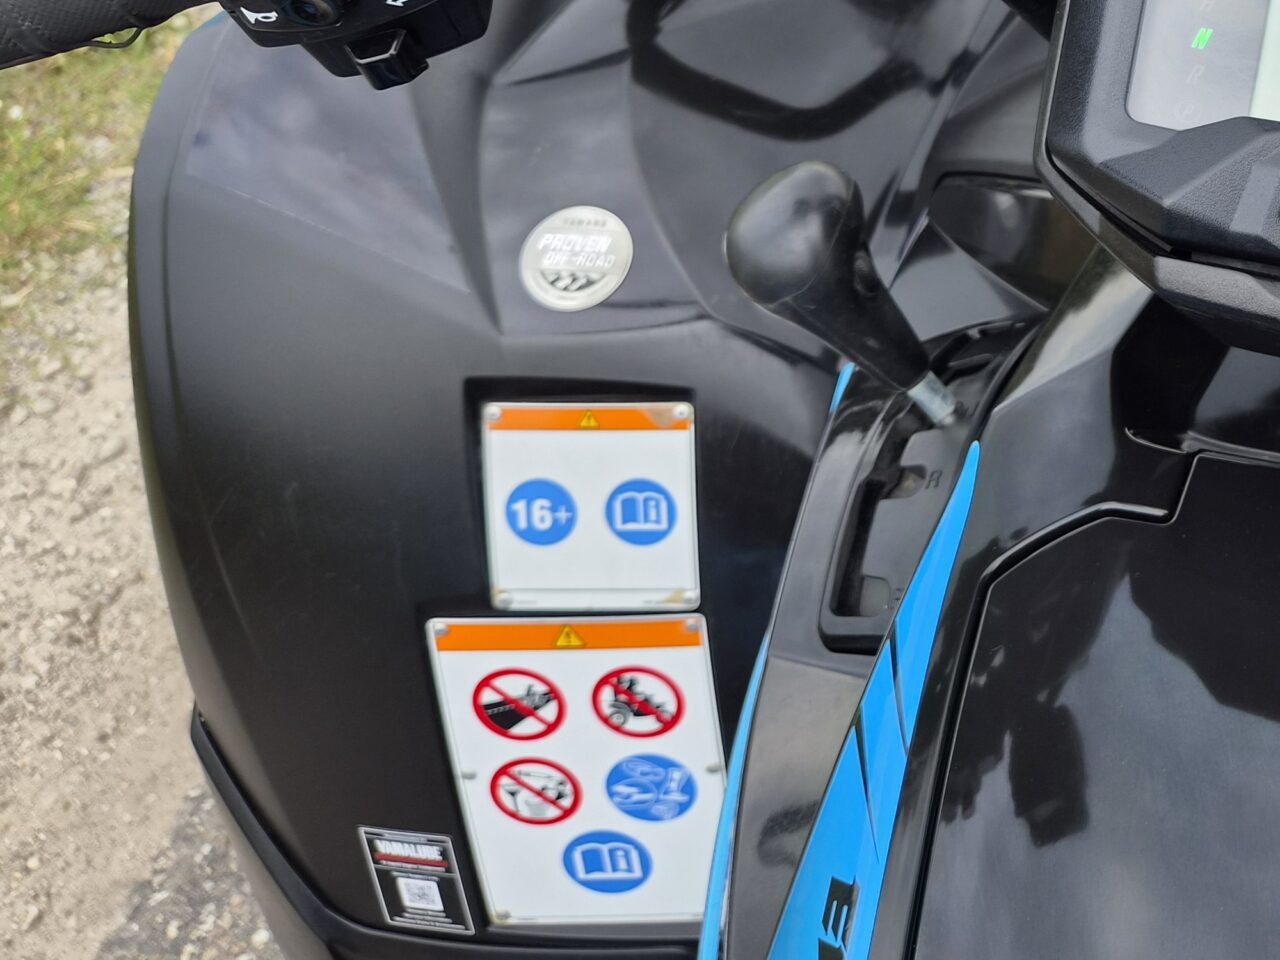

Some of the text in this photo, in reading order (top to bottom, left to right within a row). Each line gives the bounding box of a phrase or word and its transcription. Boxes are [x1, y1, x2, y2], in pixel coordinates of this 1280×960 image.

[1191, 27, 1214, 49] N
[537, 233, 612, 253] PROVEN
[510, 497, 573, 532] 16+
